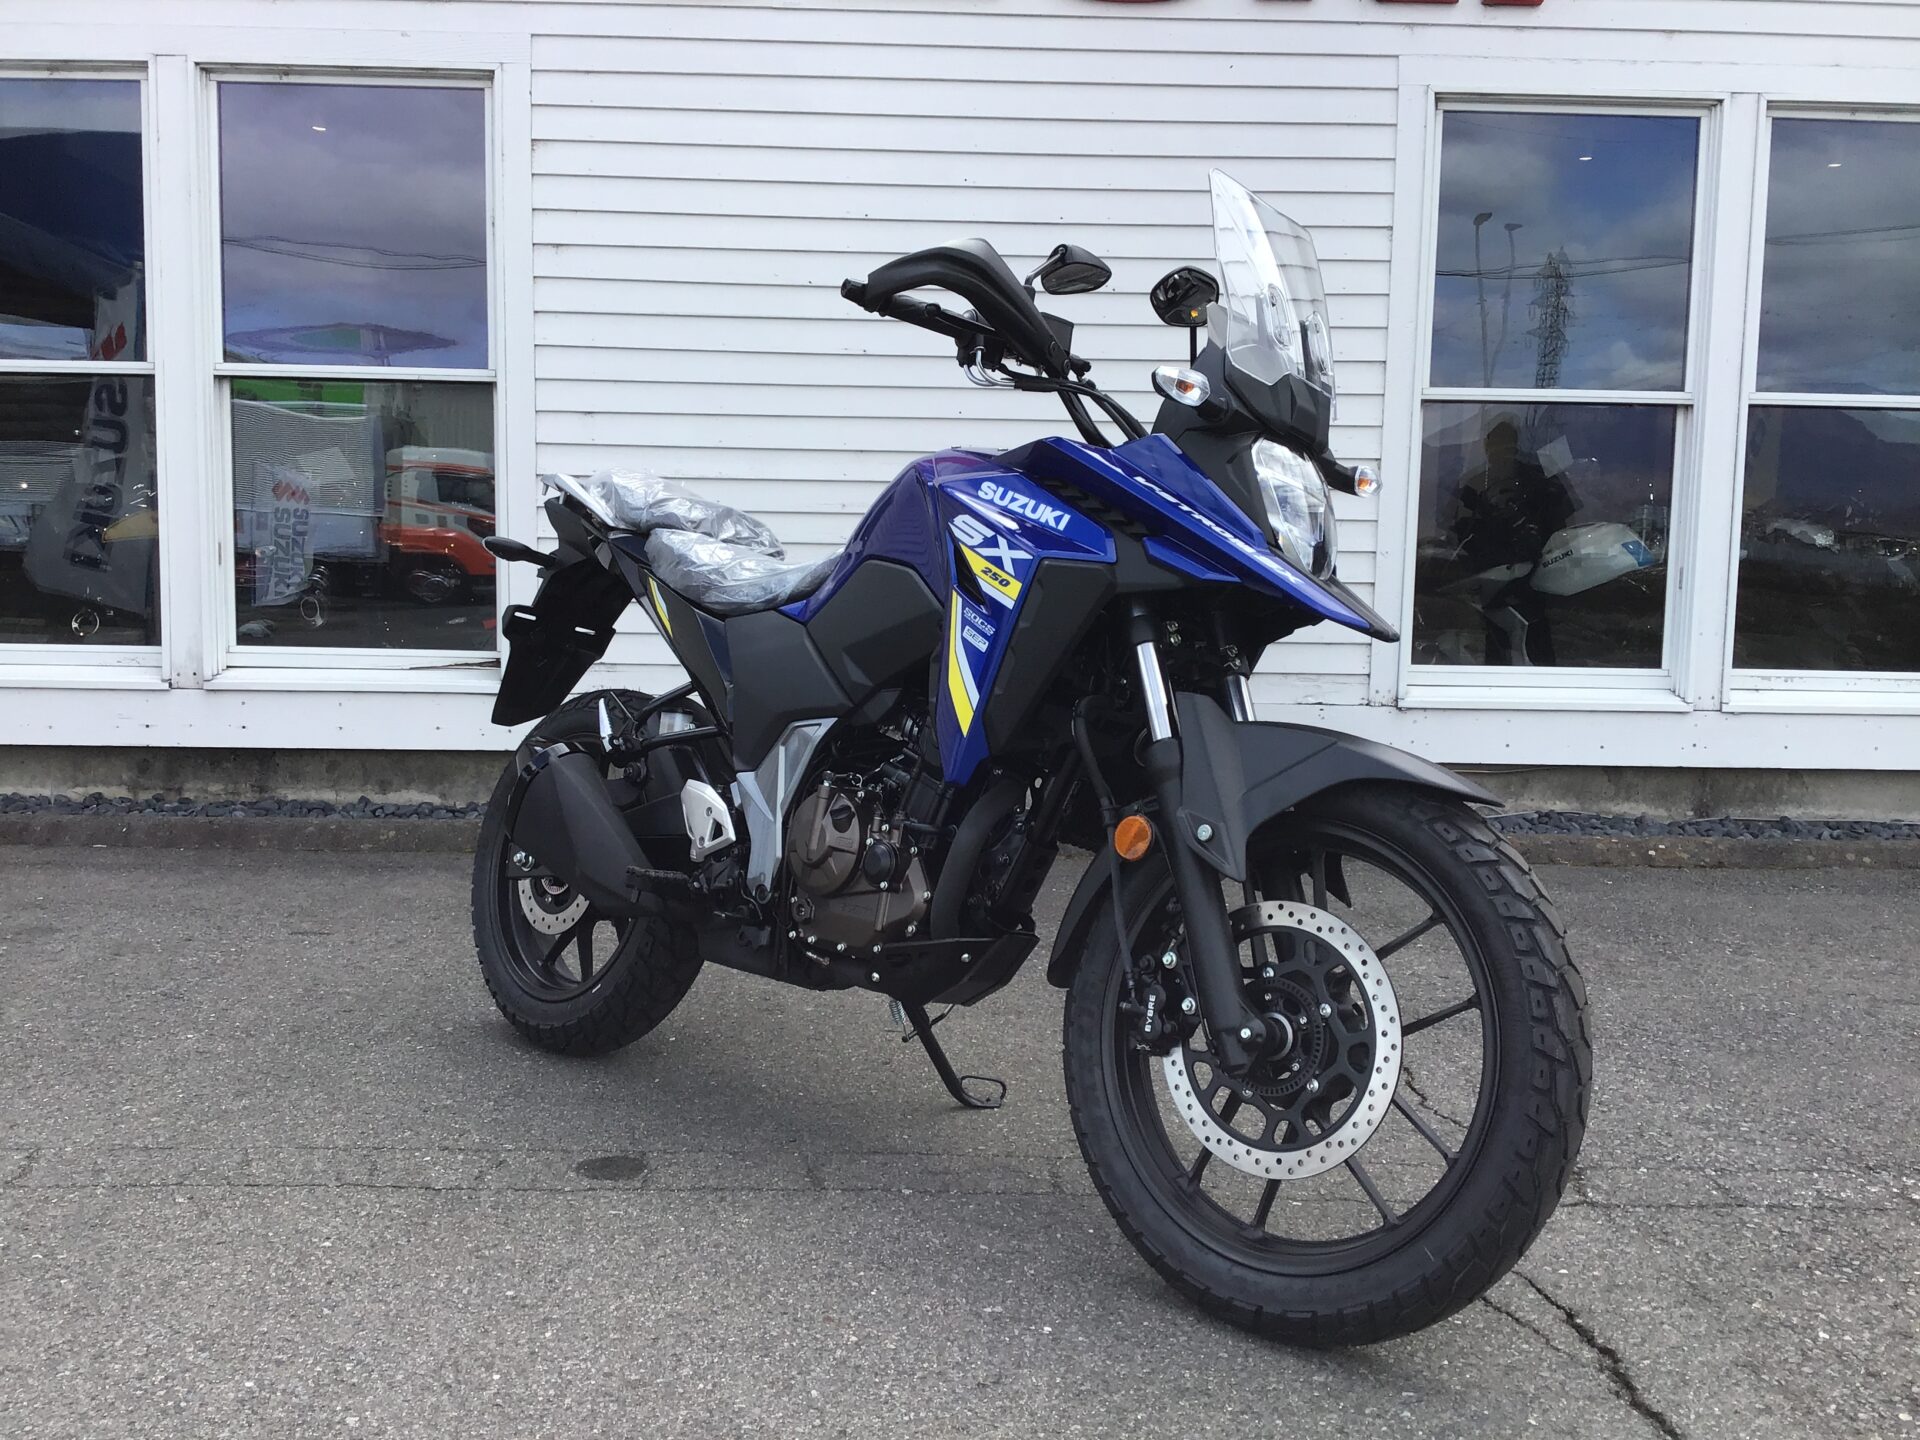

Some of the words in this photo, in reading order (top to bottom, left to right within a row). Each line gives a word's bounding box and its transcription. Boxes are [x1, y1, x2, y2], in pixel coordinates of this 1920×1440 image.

[978, 481, 1071, 531] SUZUKI
[948, 514, 1033, 577] SX
[1542, 549, 1573, 568] SUZUKI
[981, 567, 1011, 587] 250
[965, 629, 987, 646] SEP
[1144, 994, 1156, 1032] BYBRE
